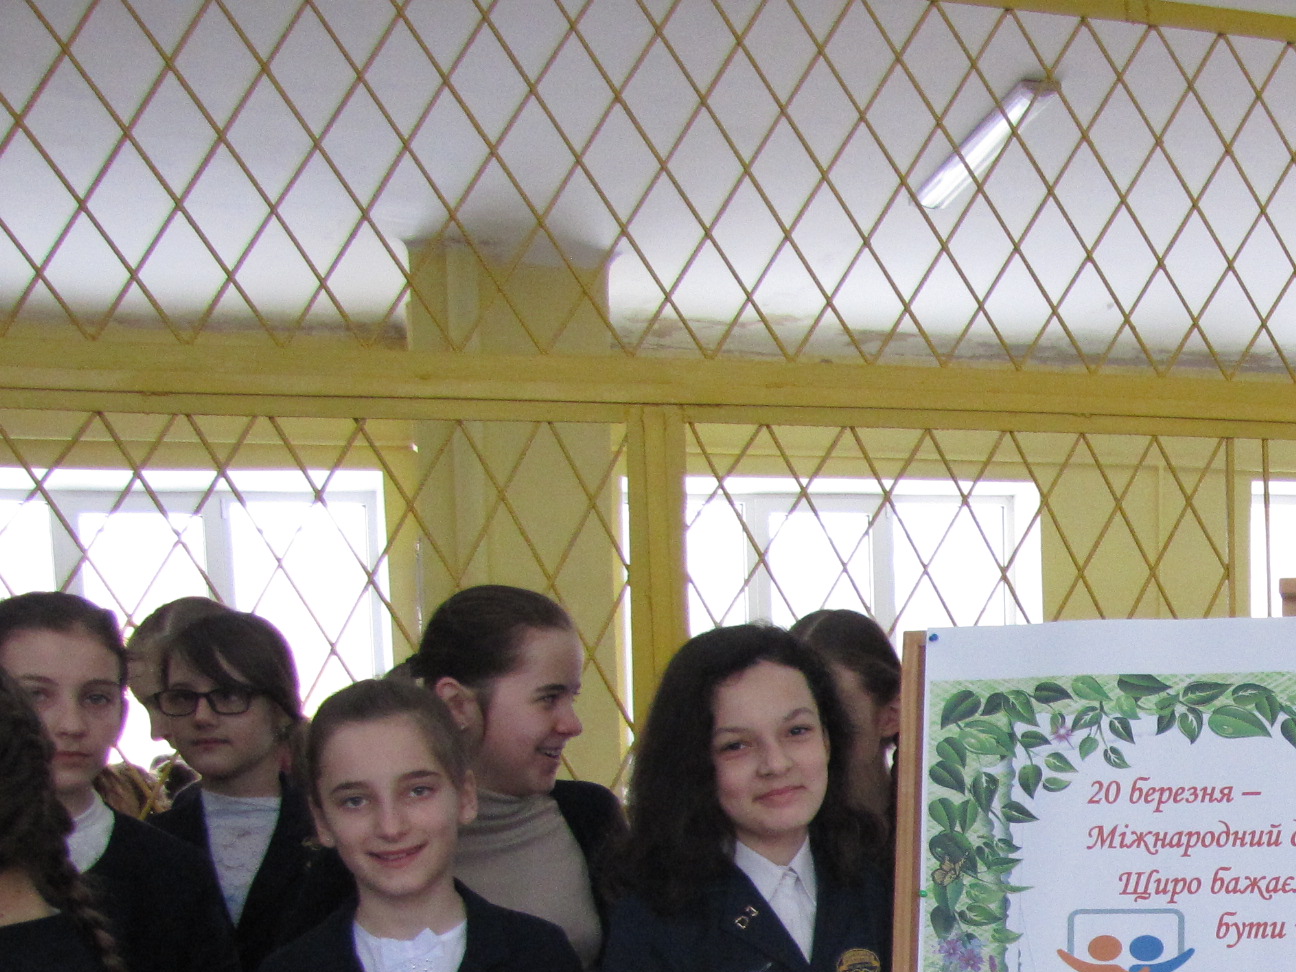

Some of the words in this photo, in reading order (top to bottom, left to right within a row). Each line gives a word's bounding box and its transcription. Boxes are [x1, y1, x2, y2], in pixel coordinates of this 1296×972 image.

[1086, 779, 1121, 805] 20
[1128, 776, 1234, 813] березня
[1086, 820, 1282, 857] Міжнародний
[1117, 868, 1202, 904] Щиро
[1215, 911, 1286, 949] бути
